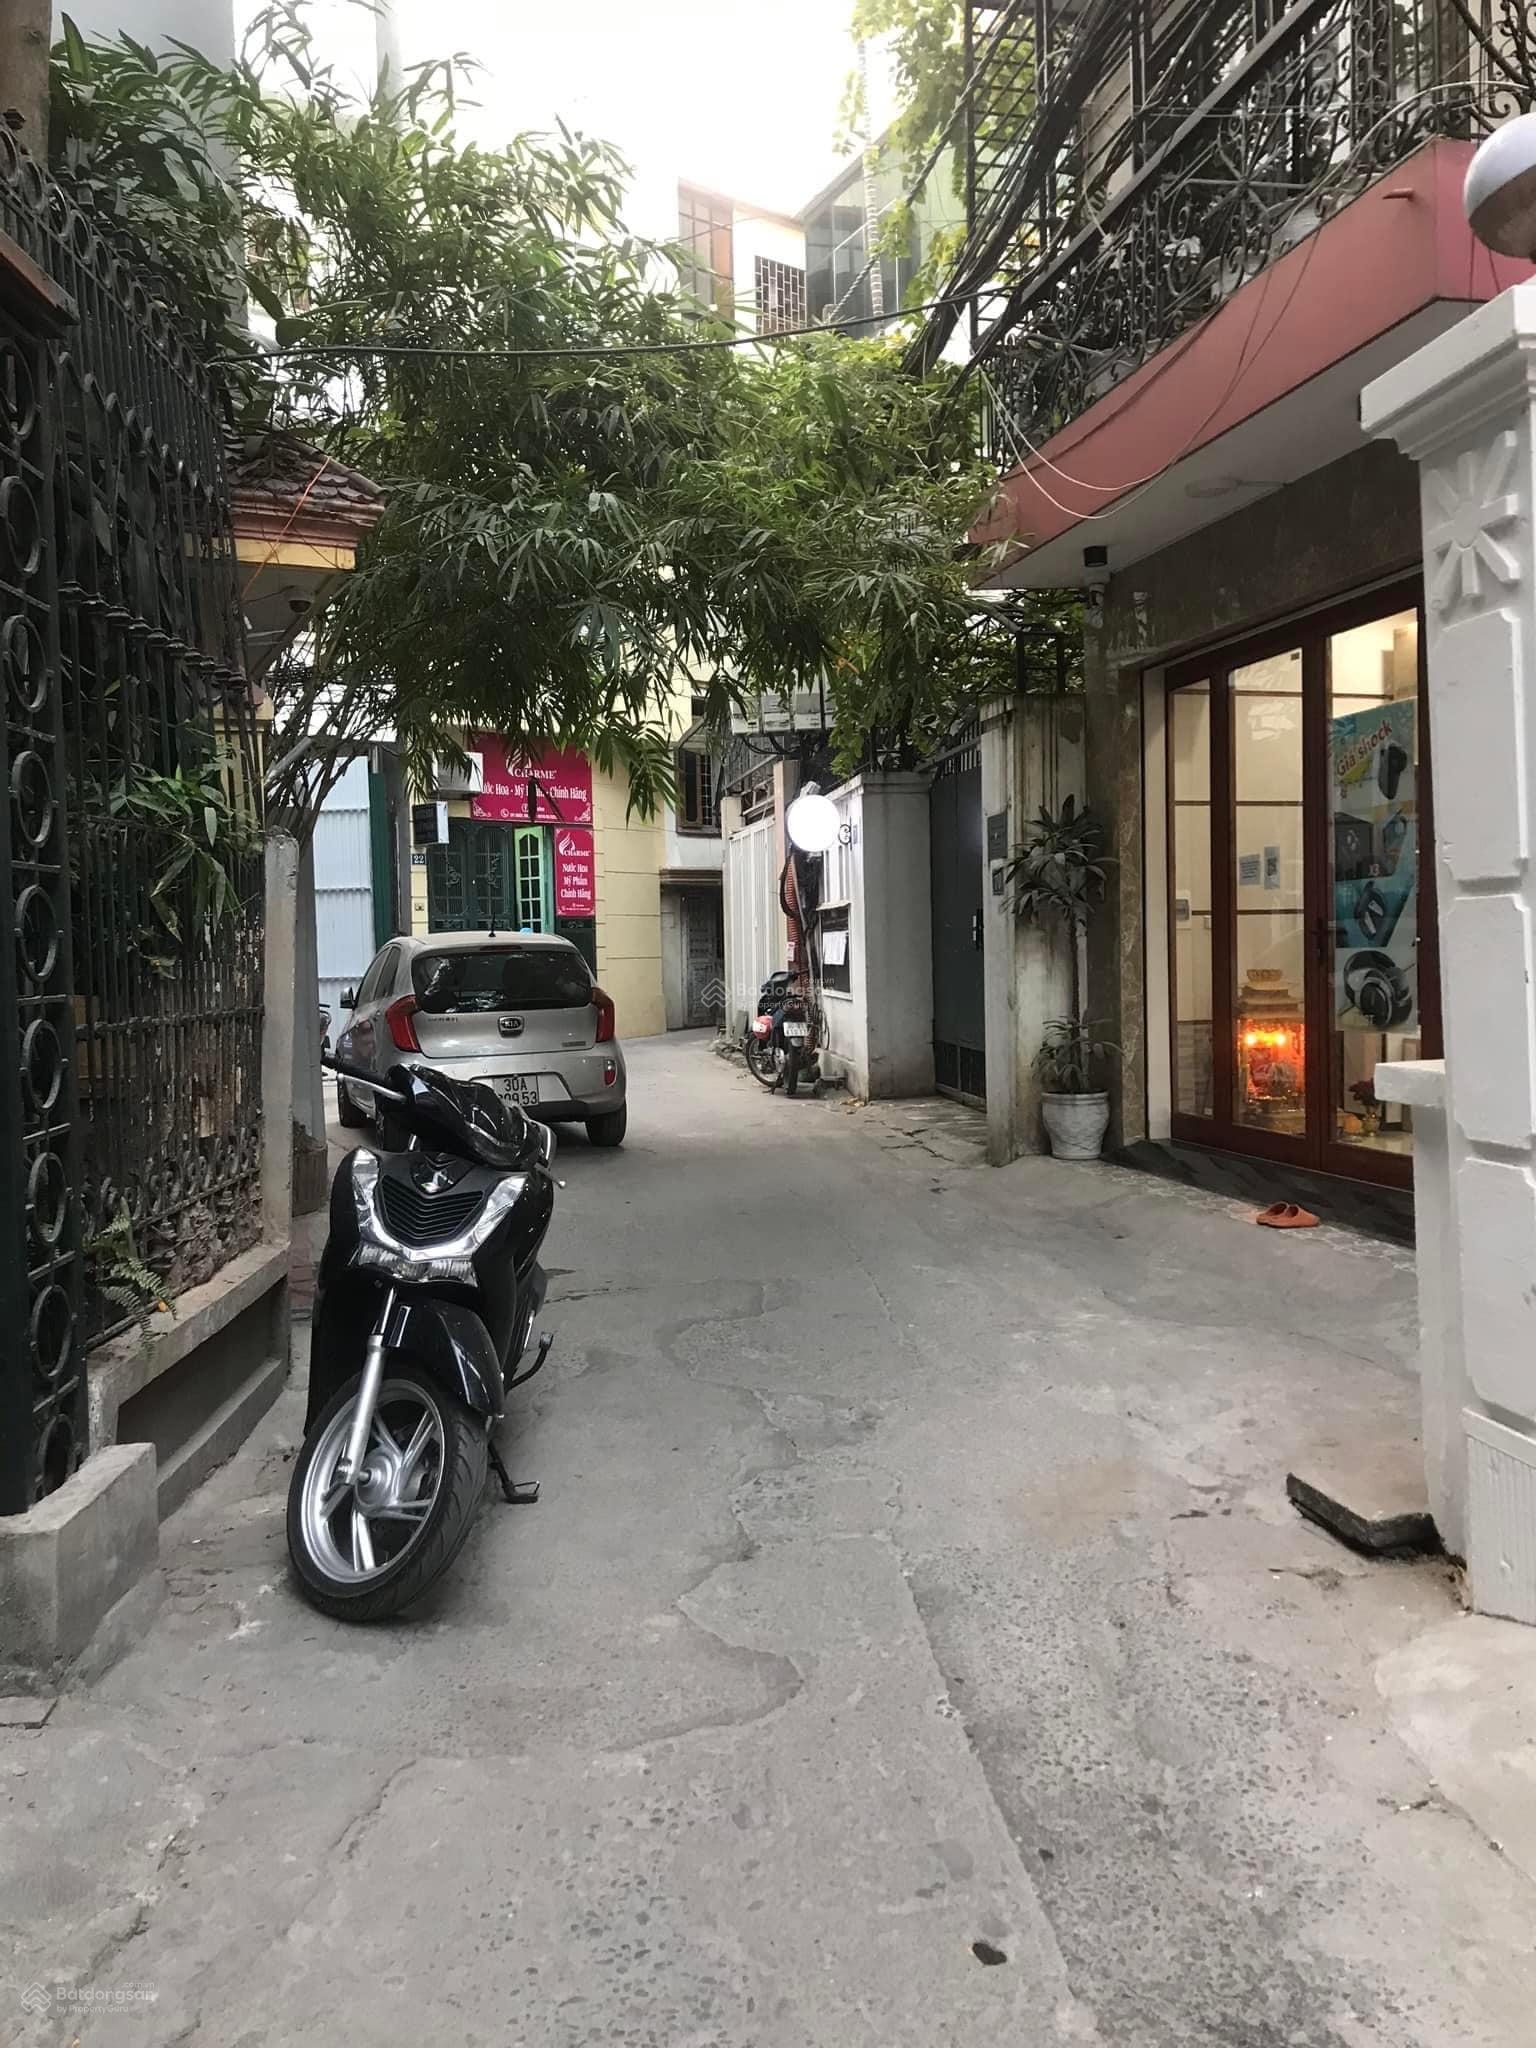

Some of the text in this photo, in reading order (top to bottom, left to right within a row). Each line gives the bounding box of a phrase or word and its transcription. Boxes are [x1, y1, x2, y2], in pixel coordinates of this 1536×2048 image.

[1358, 719, 1393, 760] shock
[481, 780, 495, 795] ước
[495, 783, 510, 796] Hoa
[549, 784, 569, 799] Chính
[413, 854, 425, 864] 22
[503, 1077, 528, 1092] 30A
